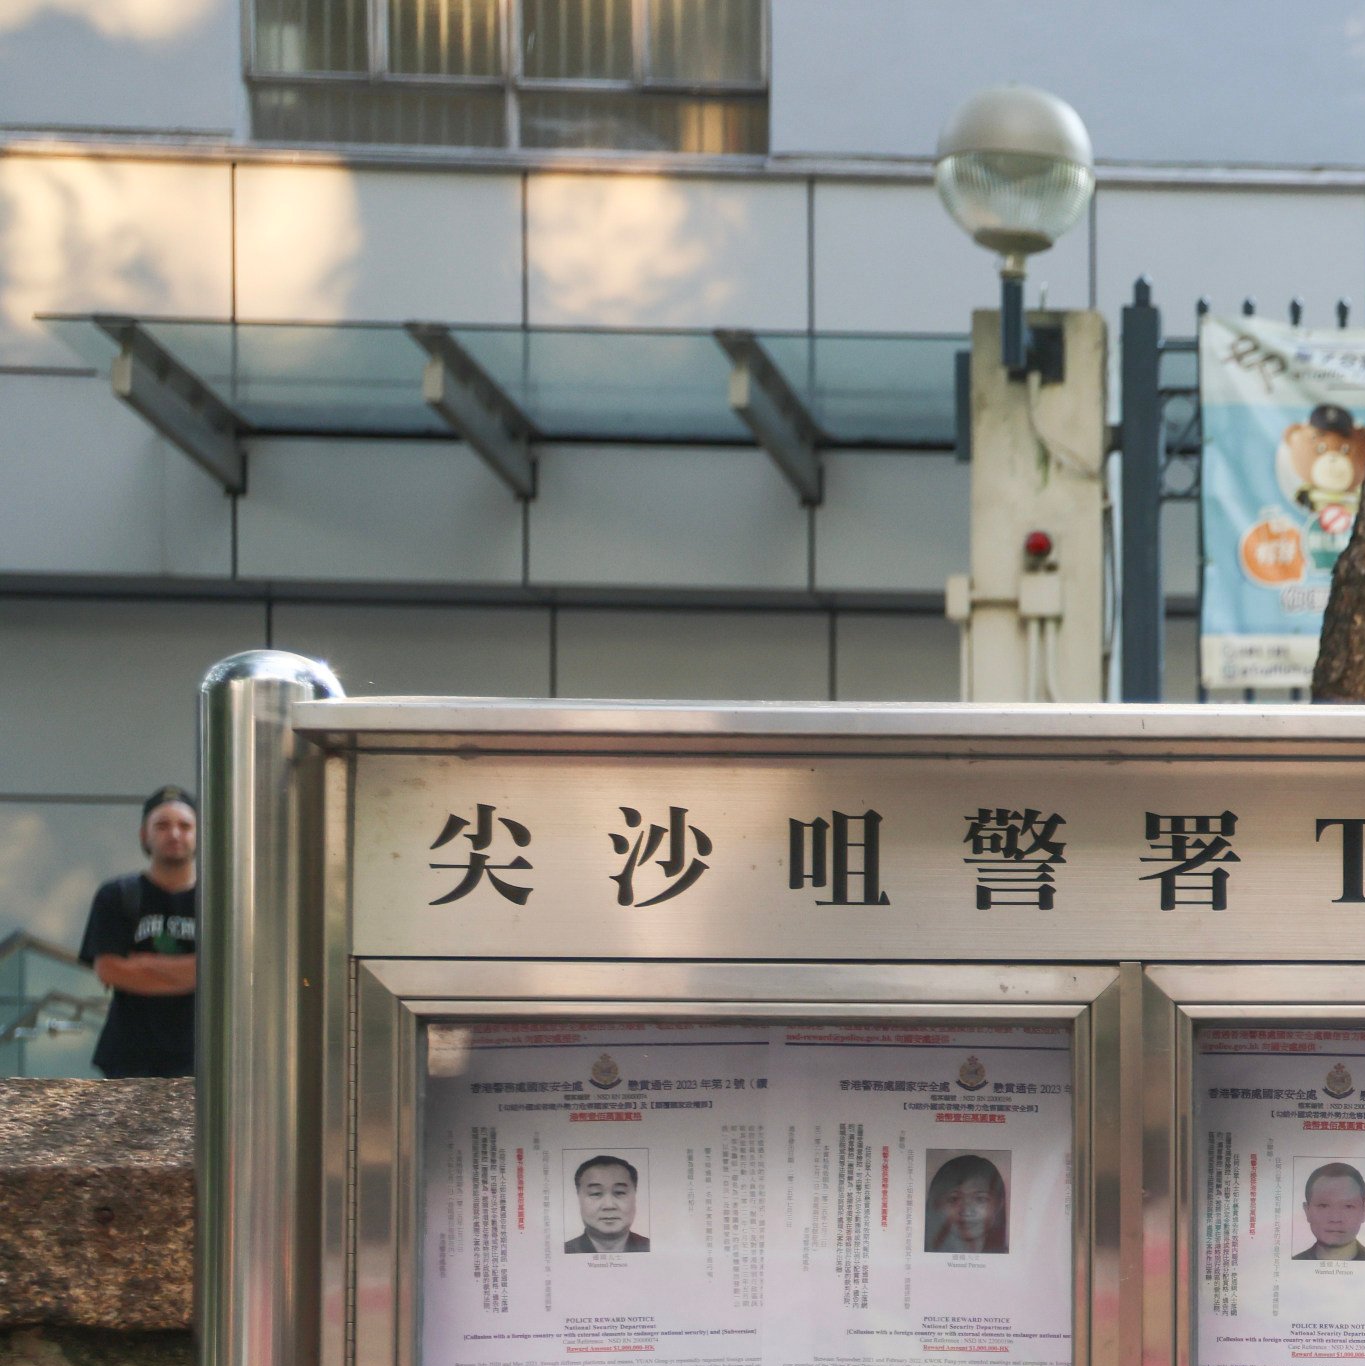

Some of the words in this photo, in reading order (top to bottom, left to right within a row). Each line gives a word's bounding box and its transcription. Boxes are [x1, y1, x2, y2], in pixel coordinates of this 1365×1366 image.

[429, 803, 1242, 912] 尖沙咀警署
[676, 1080, 697, 1089] 2023
[701, 1079, 722, 1089] 年第
[593, 1324, 618, 1332] Security
